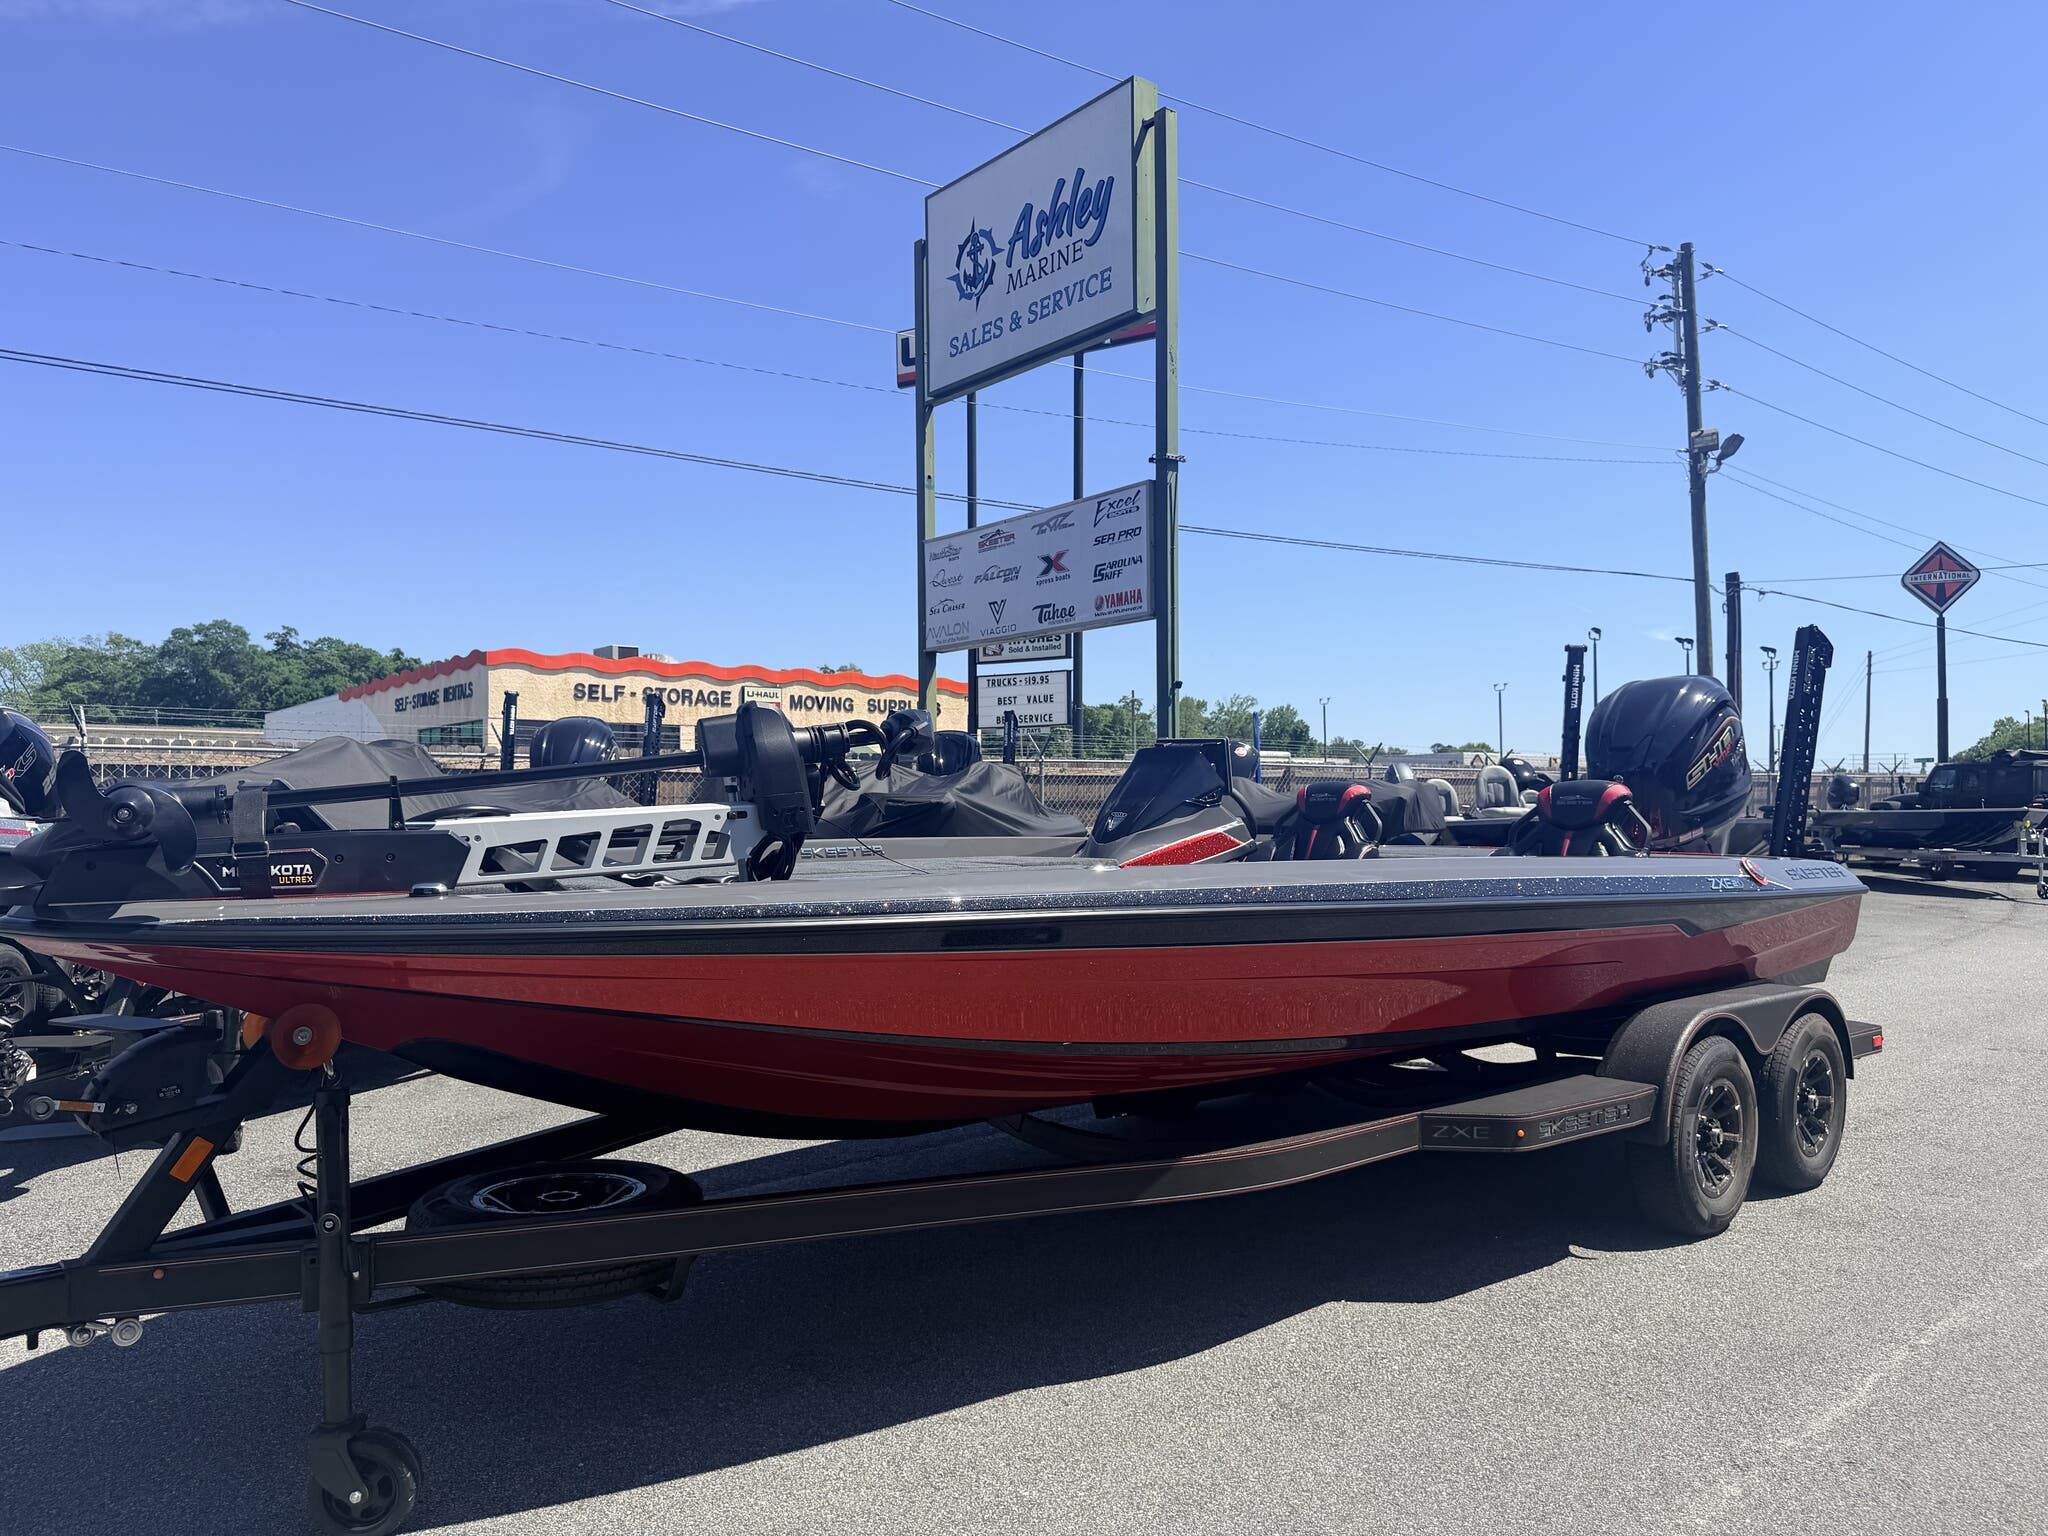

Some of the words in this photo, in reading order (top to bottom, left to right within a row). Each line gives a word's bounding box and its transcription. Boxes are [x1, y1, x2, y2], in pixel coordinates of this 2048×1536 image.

[1006, 168, 1114, 268] Ashley
[1006, 239, 1083, 294] MARINE
[949, 315, 1004, 358] SALES
[1009, 310, 1022, 332] &
[1027, 267, 1112, 325] SERVICE
[1118, 526, 1142, 541] PRO
[974, 566, 1021, 584] FALCON
[1036, 576, 1054, 586] xpress
[1055, 574, 1071, 582] boats
[1910, 571, 1971, 582] INTERNATIONAL
[1104, 589, 1143, 609] YAMAHA
[1032, 603, 1077, 624] Tahoe
[927, 621, 970, 639] AVALON
[980, 624, 1016, 637] VIAGGIO
[1032, 643, 1062, 652] Installed
[986, 677, 1017, 688] TRUCKS
[573, 683, 626, 703] SELF
[746, 690, 780, 699] U-HAUL
[997, 696, 1018, 706] BEST
[1026, 694, 1054, 704] VALUE
[789, 694, 855, 713] MOVING
[1018, 713, 1053, 724] SERVICE
[800, 845, 885, 859] SKEETER
[270, 864, 313, 877] KOTA
[278, 875, 313, 884] ULTREX
[1538, 1103, 1631, 1139] SKEETER
[1432, 1125, 1490, 1140] ZXE
